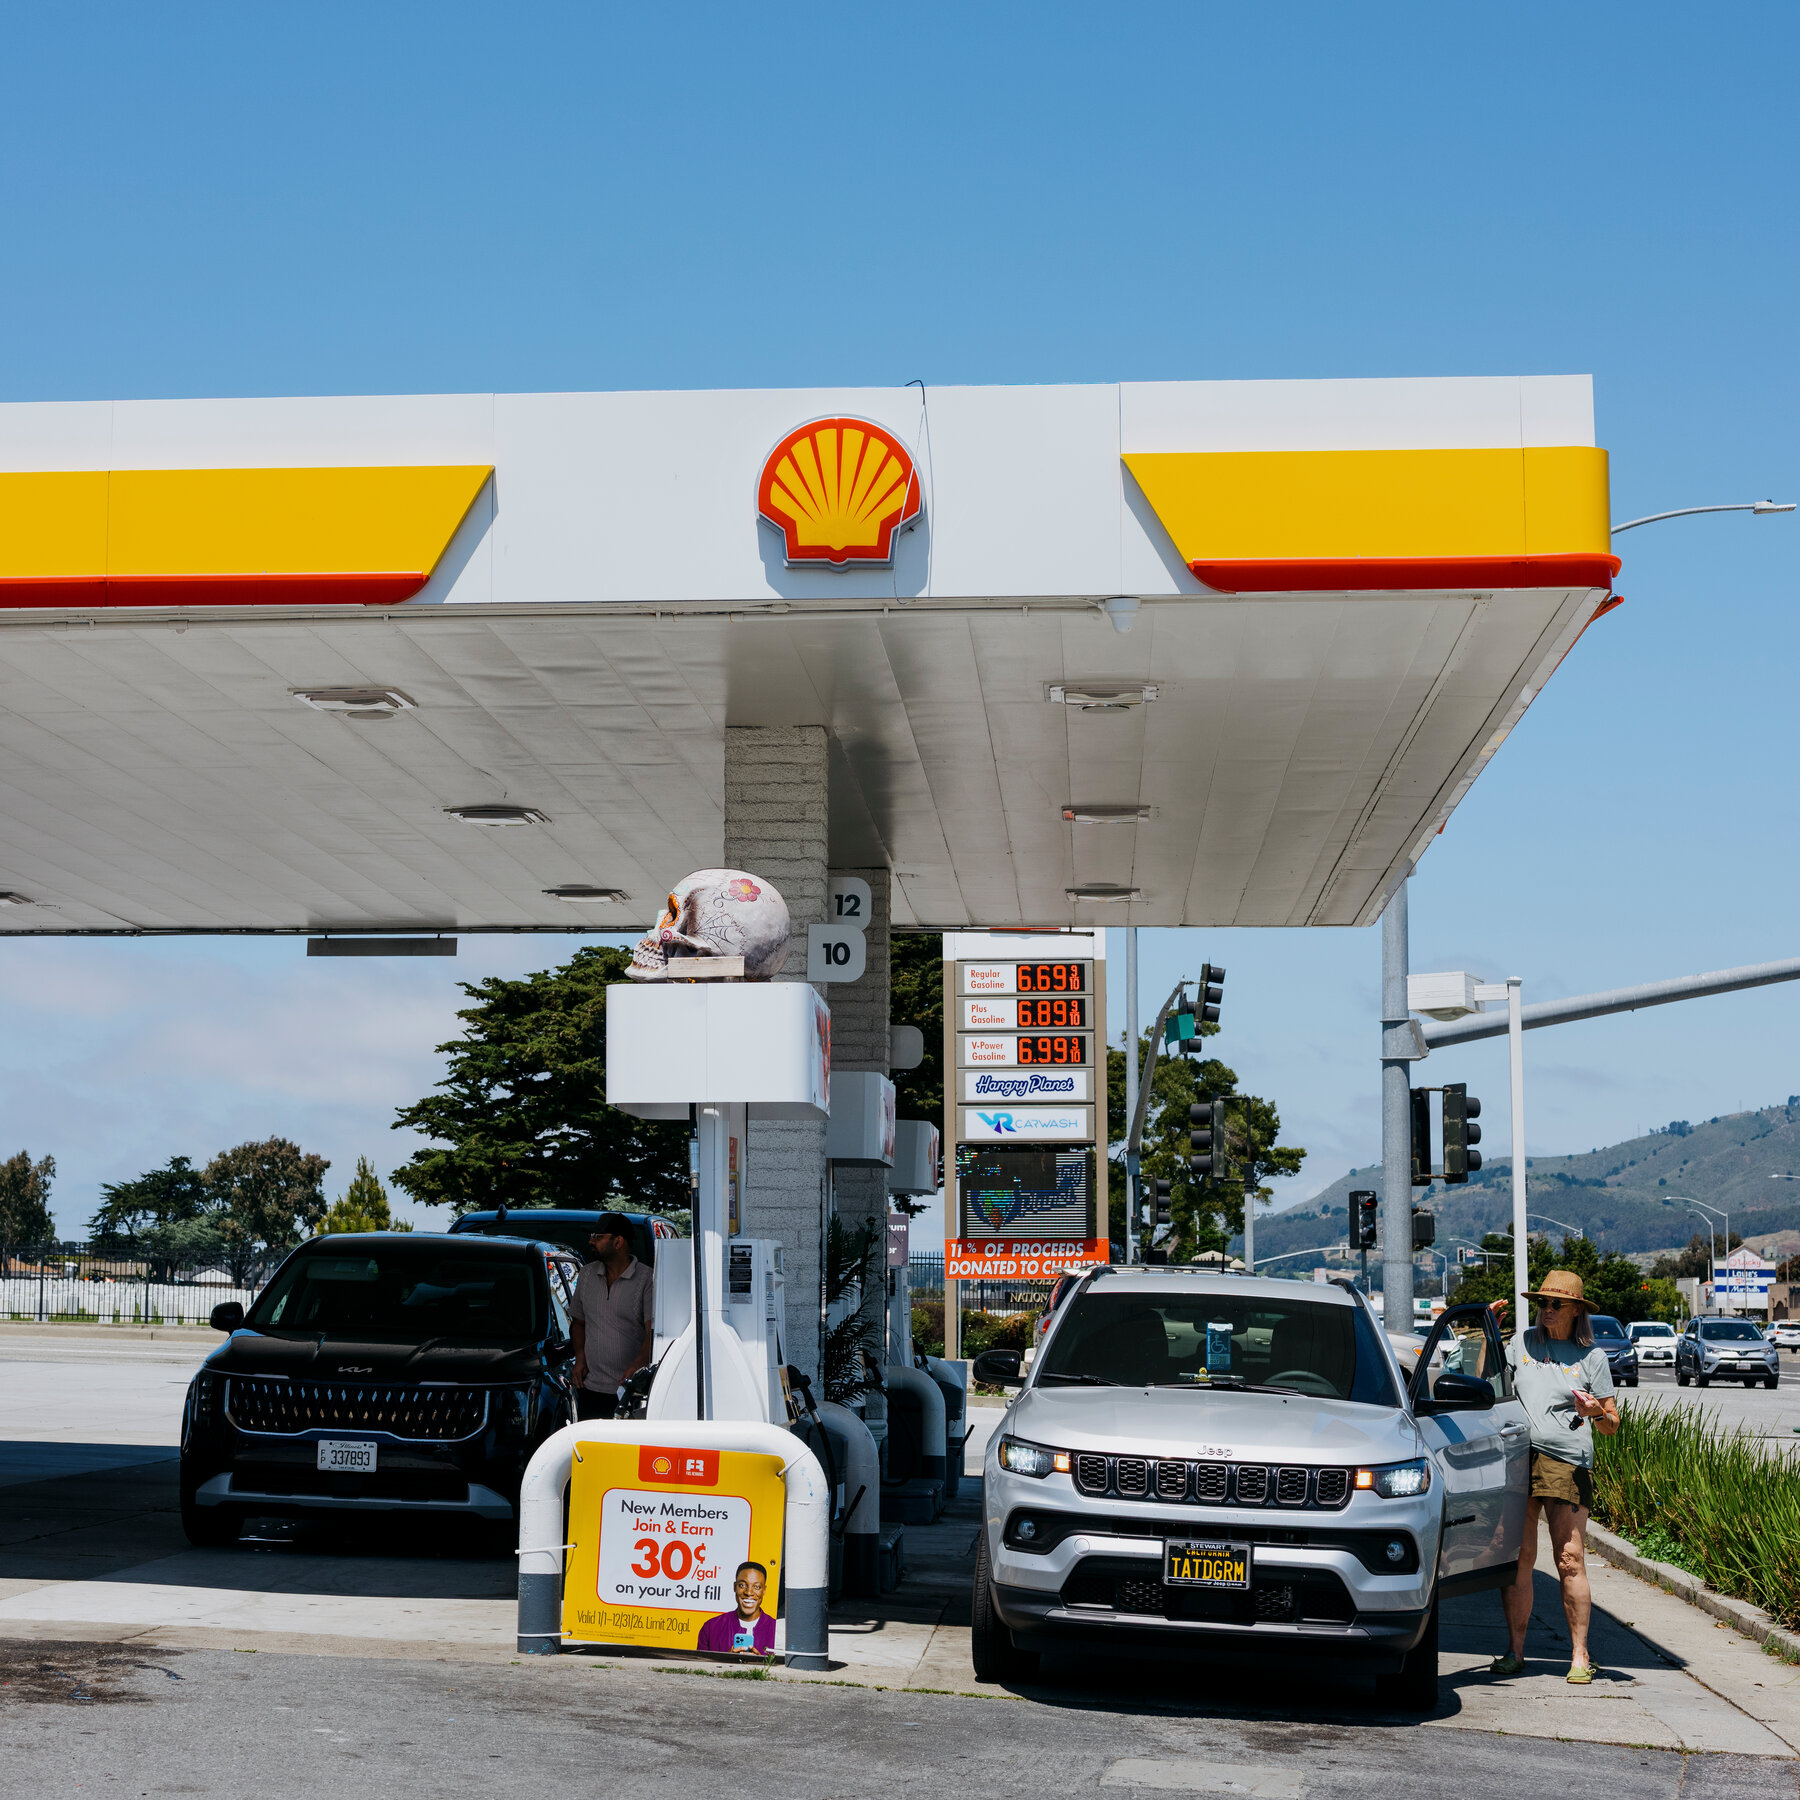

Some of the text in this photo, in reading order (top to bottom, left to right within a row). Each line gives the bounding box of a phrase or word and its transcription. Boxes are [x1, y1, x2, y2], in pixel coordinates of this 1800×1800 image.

[834, 894, 861, 917] 12
[822, 942, 851, 966] 10
[970, 969, 1001, 981] Regular
[1017, 965, 1067, 991] 6.69
[970, 980, 1005, 989] Gasoline
[971, 1004, 987, 1013] Plus
[1018, 1000, 1067, 1026] 6.89
[971, 1015, 1006, 1024] Gasoline
[971, 1041, 1004, 1050] V-Power
[1018, 1037, 1068, 1063] 6.99
[971, 1052, 1006, 1061] Gasoline
[976, 1074, 1075, 1097] Hangry Planet
[976, 1112, 1078, 1135] VR CARWASH
[950, 1243, 963, 1258] 11
[984, 1243, 1005, 1258] OF
[1011, 1243, 1084, 1258] PROCEEDS
[948, 1260, 1018, 1275] DONATED
[1020, 1260, 1040, 1275] TO
[330, 1449, 370, 1467] 337893
[1197, 1445, 1233, 1458] Jeep
[621, 1499, 729, 1520] New Members
[632, 1517, 714, 1536] Join & Earn
[1171, 1557, 1244, 1582] TATDGRM
[615, 1584, 721, 1600] on your 3rd fill
[577, 1610, 596, 1625] Valid
[646, 1616, 666, 1631] Limit
